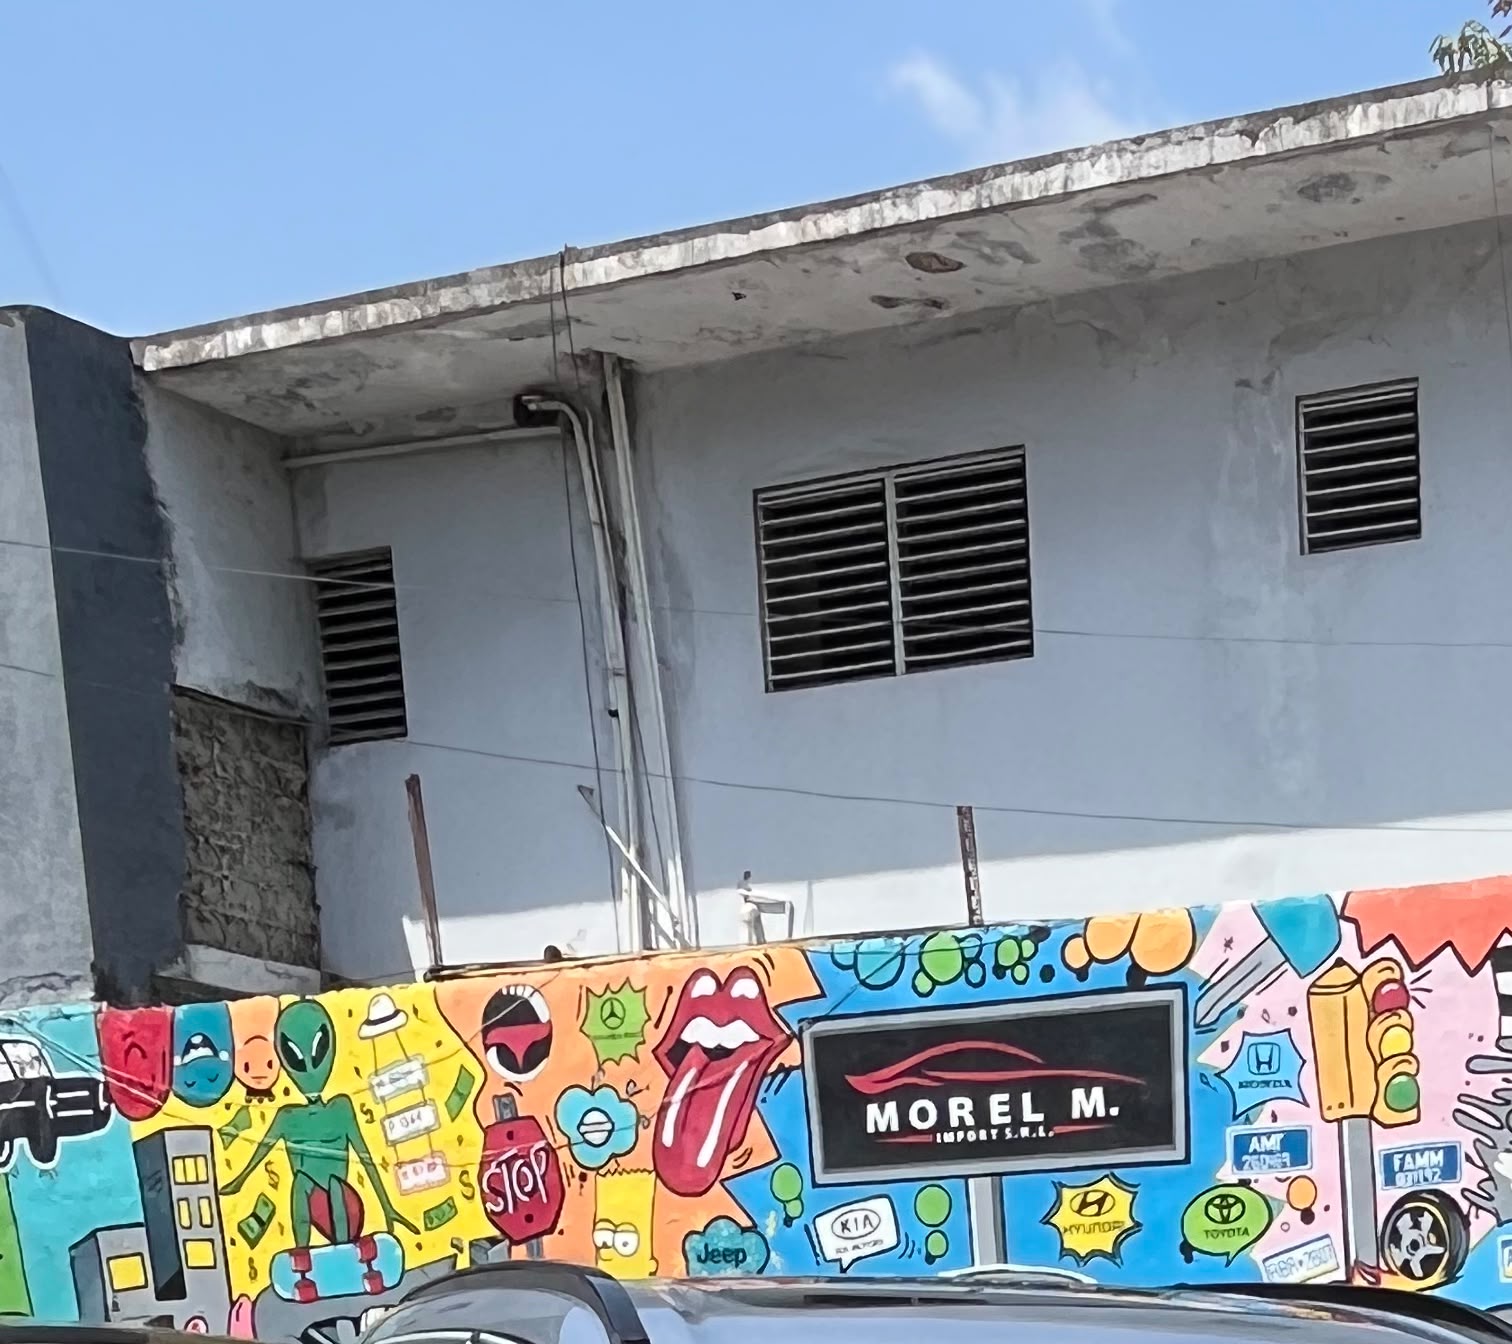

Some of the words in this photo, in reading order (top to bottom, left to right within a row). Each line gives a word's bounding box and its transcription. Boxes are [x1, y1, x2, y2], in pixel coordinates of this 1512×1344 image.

[865, 1091, 1045, 1134] MOREL
[1071, 1086, 1121, 1120] M.
[936, 1127, 998, 1144] IMPORT
[1393, 1148, 1444, 1172] FAMM
[482, 1139, 548, 1215] STOP
[840, 1214, 876, 1235] KIA
[1202, 1227, 1250, 1240] TOYOTA
[696, 1242, 747, 1268] Jeep
